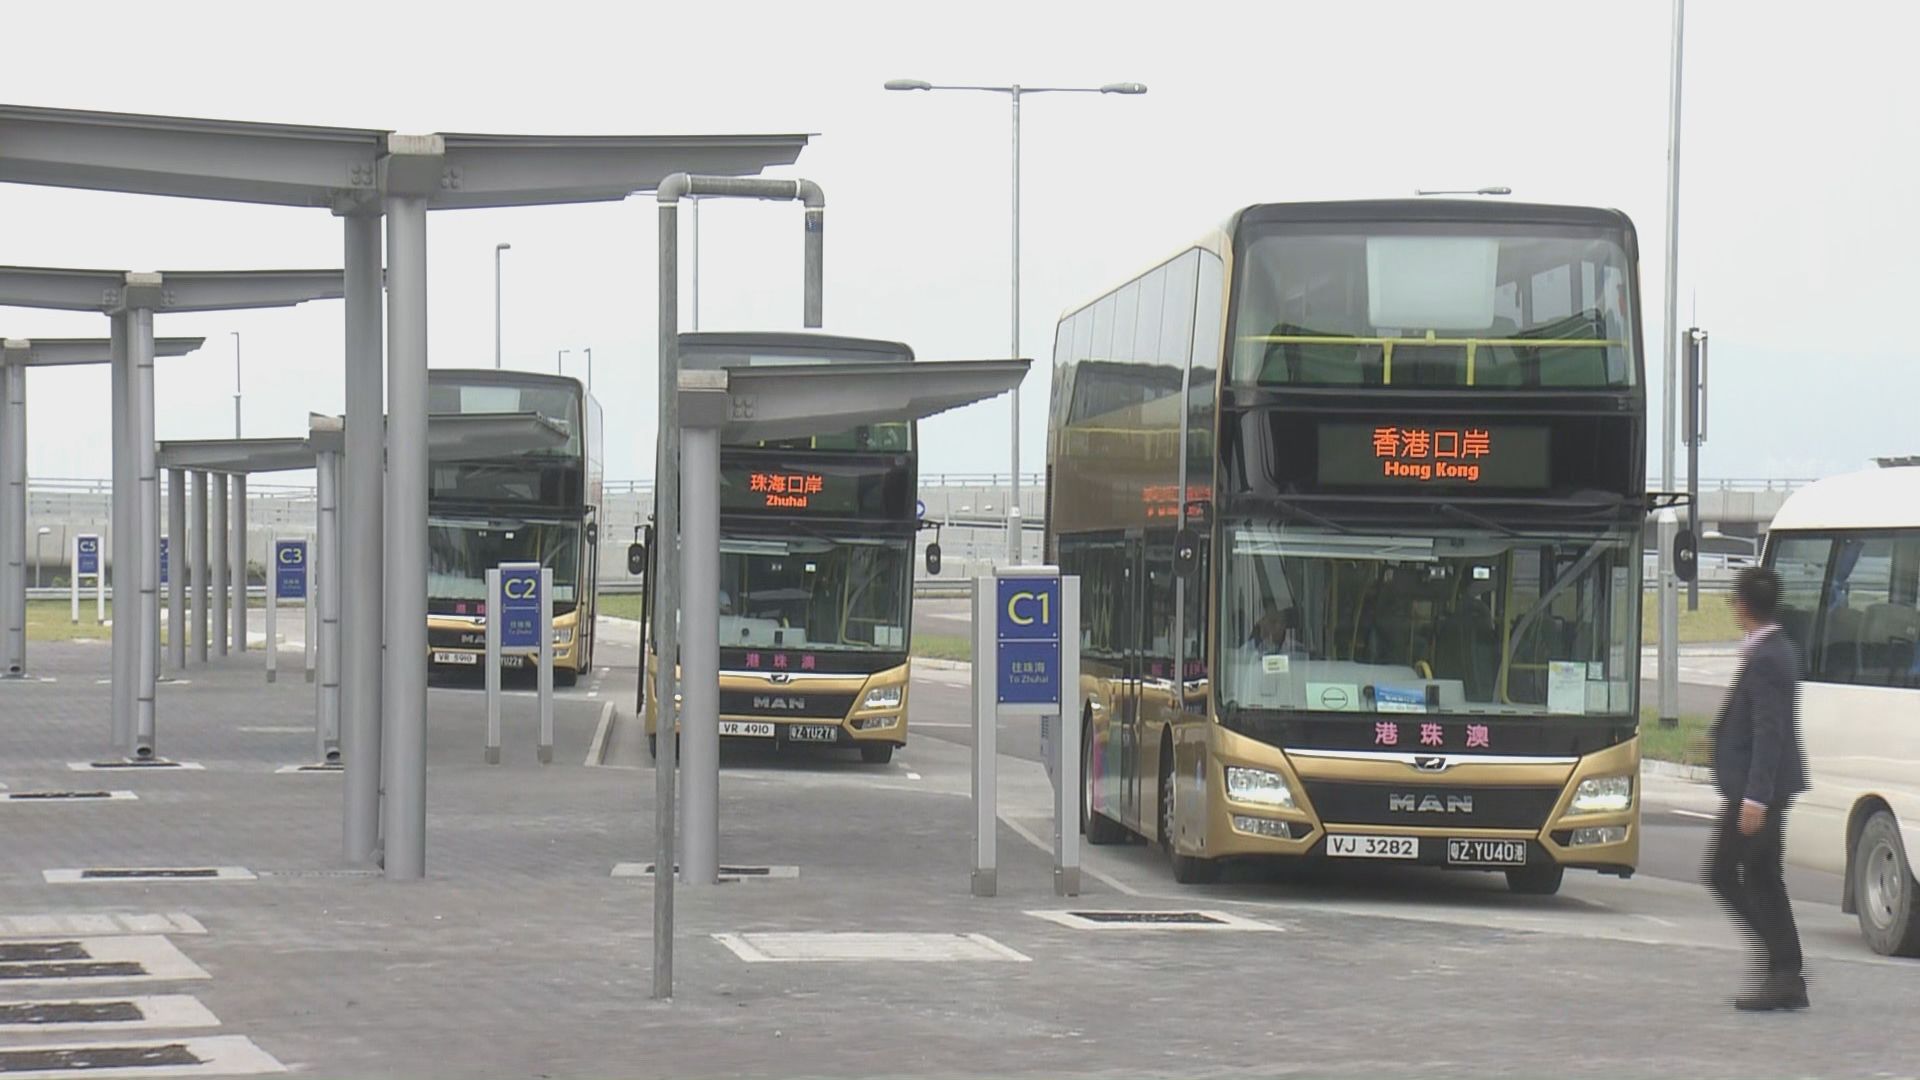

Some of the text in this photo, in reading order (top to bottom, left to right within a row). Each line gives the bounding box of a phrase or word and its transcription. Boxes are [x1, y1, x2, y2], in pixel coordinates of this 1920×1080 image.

[1373, 427, 1490, 459] 香港口岸
[1384, 461, 1479, 481] Hong Kong
[750, 474, 823, 494] 珠海口岸
[766, 495, 807, 507] Zhuhai
[80, 541, 96, 552] C5
[280, 548, 302, 563] C3
[505, 579, 536, 599] C2
[1008, 592, 1049, 625] C1
[461, 634, 486, 643] MA
[753, 696, 805, 709] MAN
[724, 723, 769, 734] VR 4910
[1375, 722, 1489, 748] 港珠澳
[1389, 793, 1473, 812] MAN
[1333, 838, 1413, 855] VJ 3282
